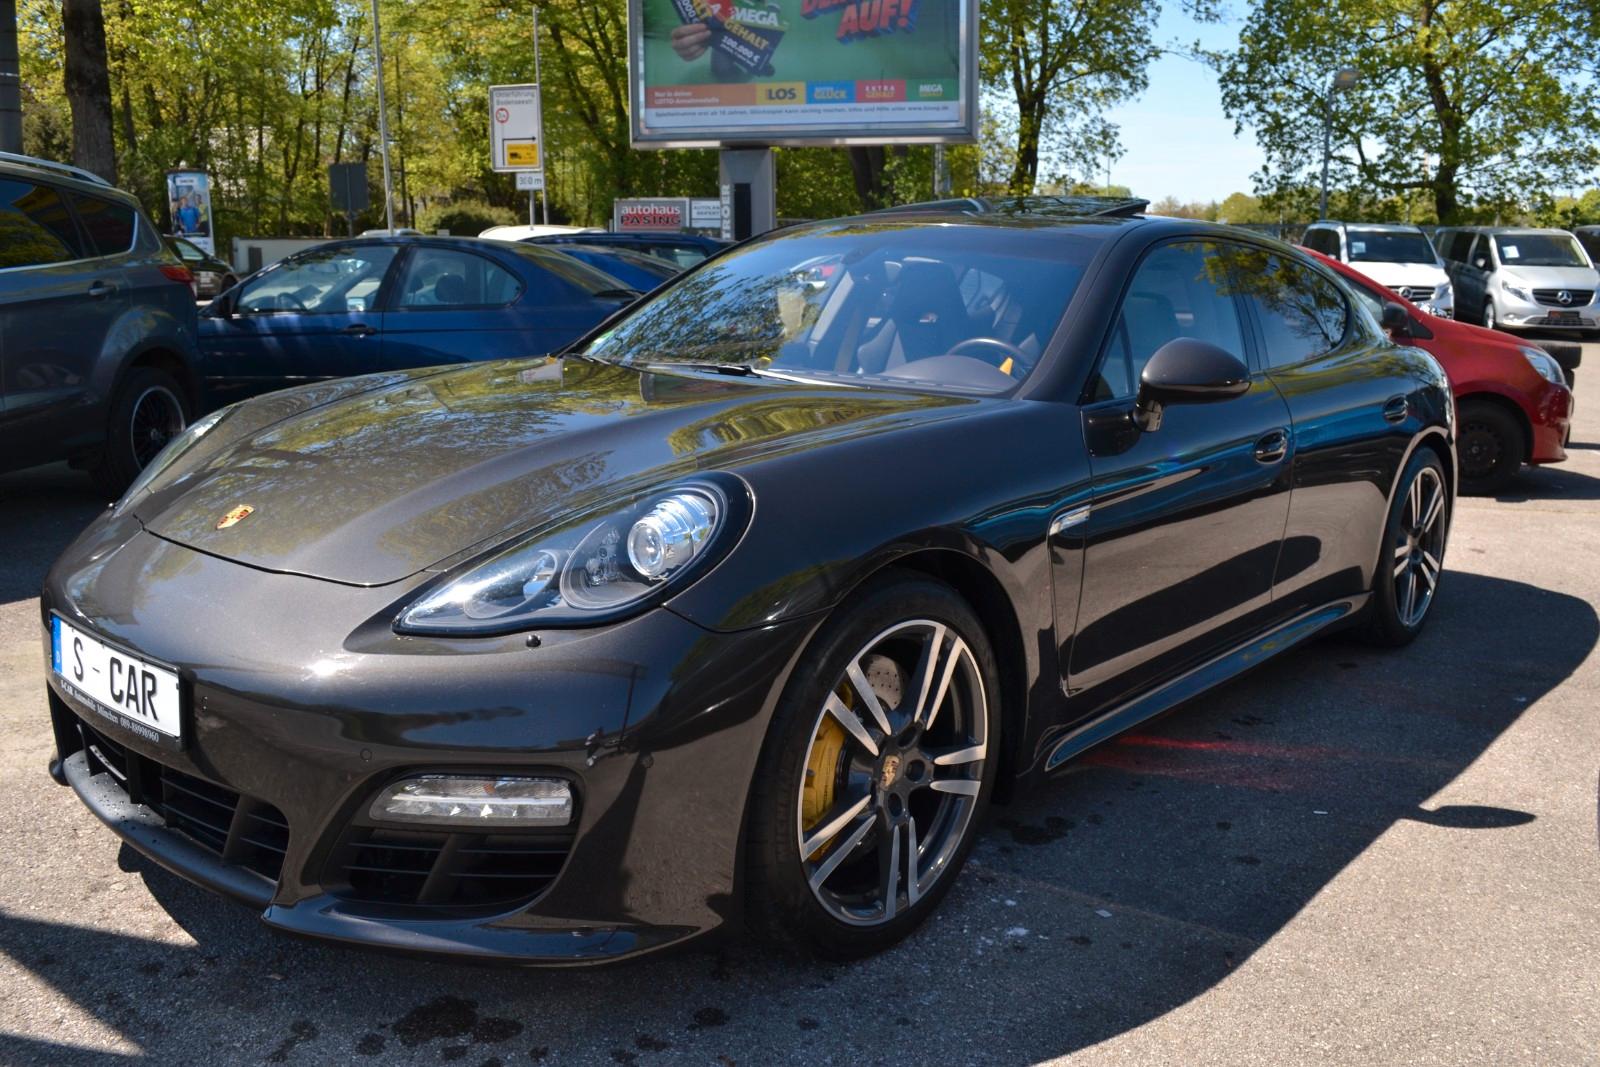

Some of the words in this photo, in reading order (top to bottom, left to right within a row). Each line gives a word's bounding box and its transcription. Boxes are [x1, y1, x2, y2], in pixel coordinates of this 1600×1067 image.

[733, 5, 779, 27] MEGA
[723, 19, 769, 50] GEHALT
[768, 88, 797, 100] LOS
[621, 203, 681, 214] autohaus
[621, 215, 681, 224] PASING
[73, 636, 84, 682] S
[109, 656, 159, 722] CAR
